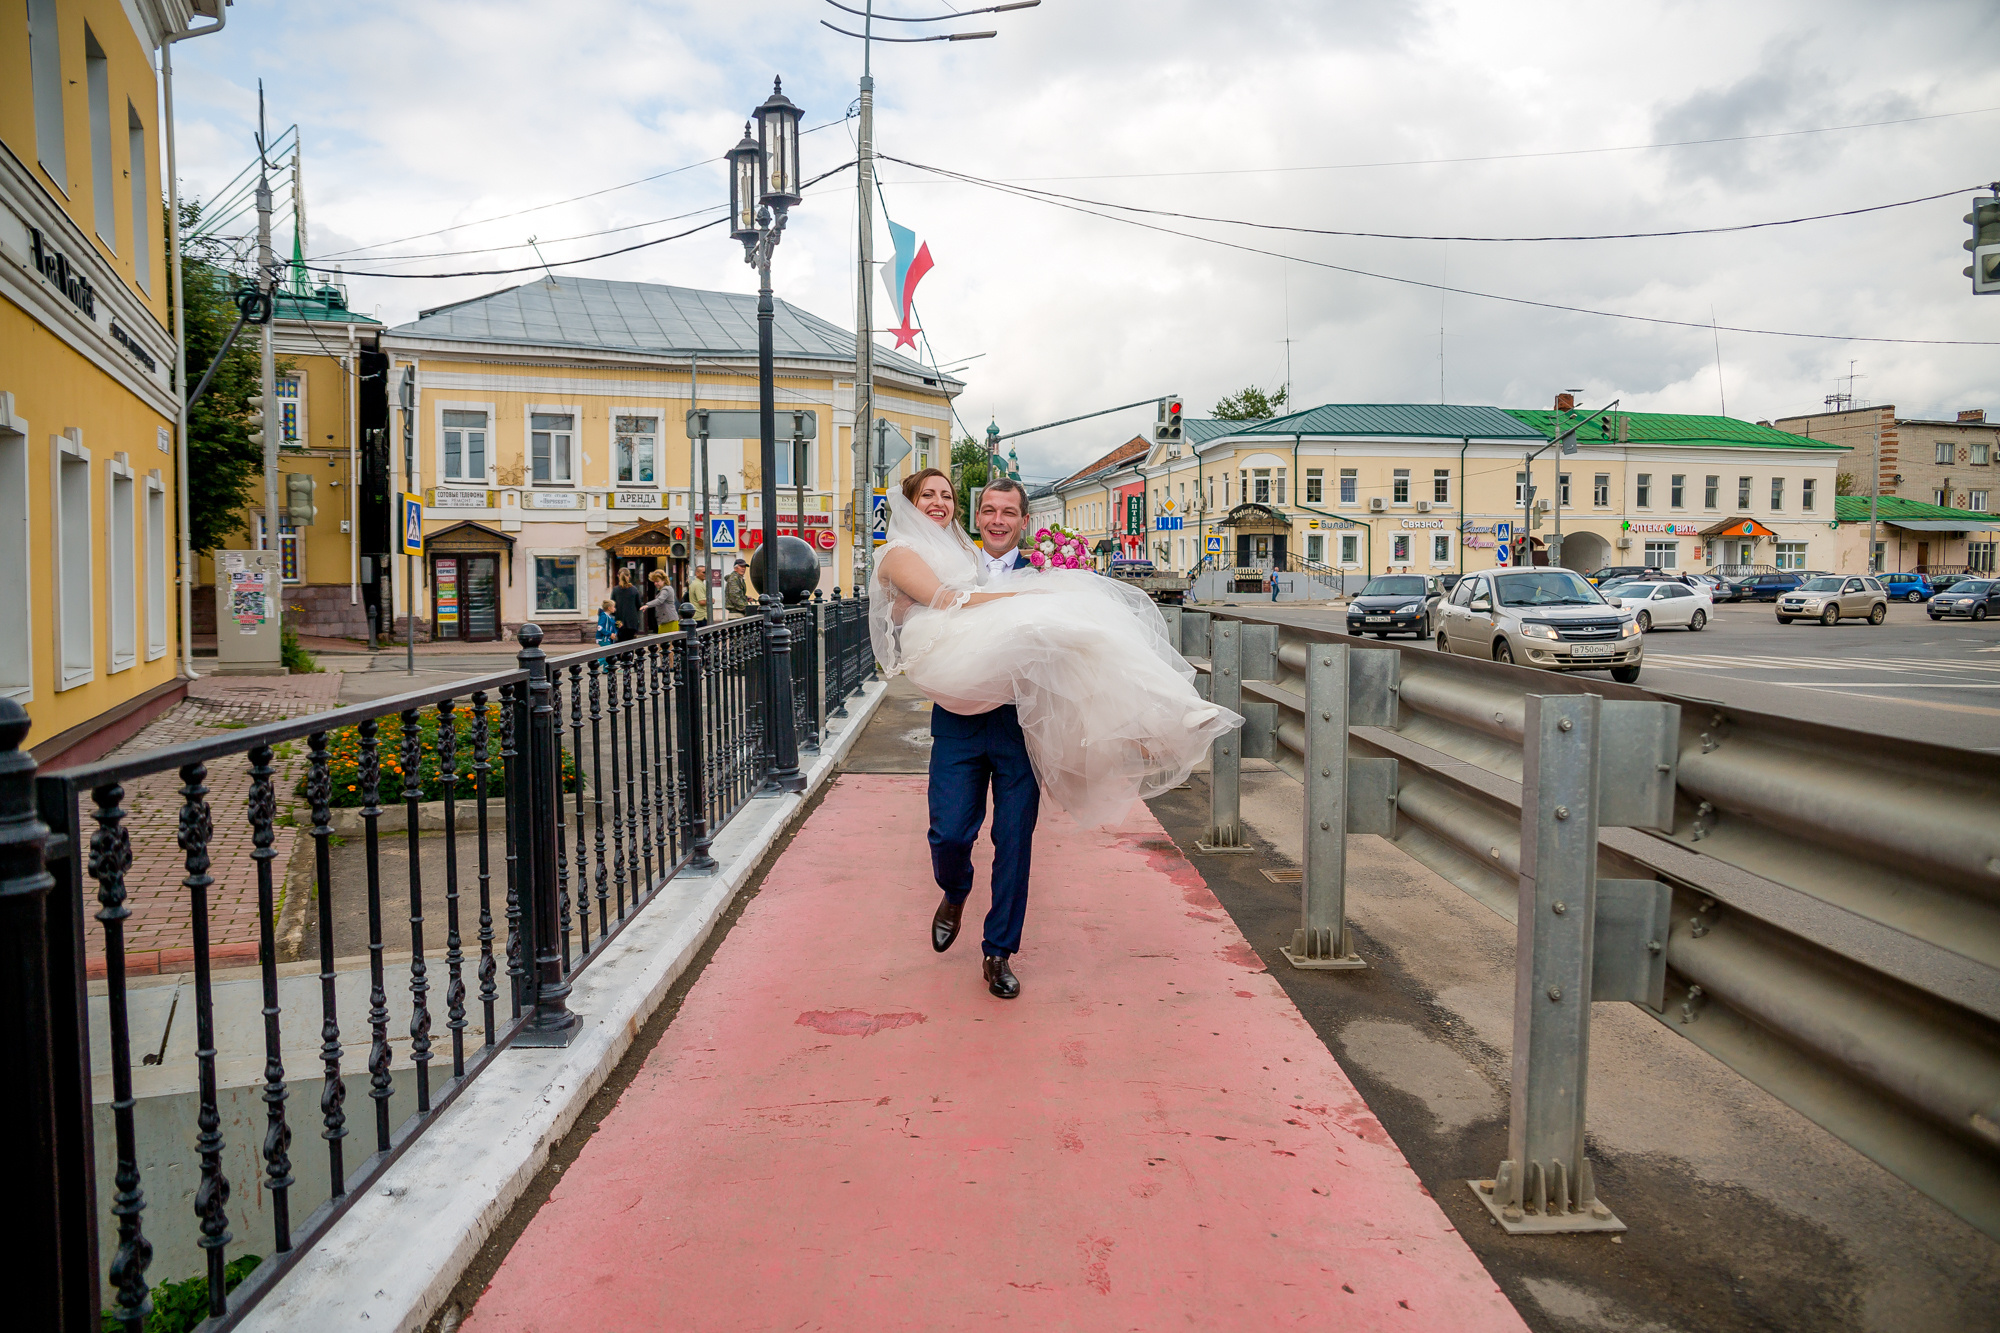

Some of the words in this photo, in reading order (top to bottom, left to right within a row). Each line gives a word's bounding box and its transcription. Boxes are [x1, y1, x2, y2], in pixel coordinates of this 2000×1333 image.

[619, 493, 656, 504] АРЕНДА
[1401, 518, 1444, 529] Связной
[1630, 523, 1665, 532] АПТЕКА
[1675, 524, 1698, 533] ВИТА
